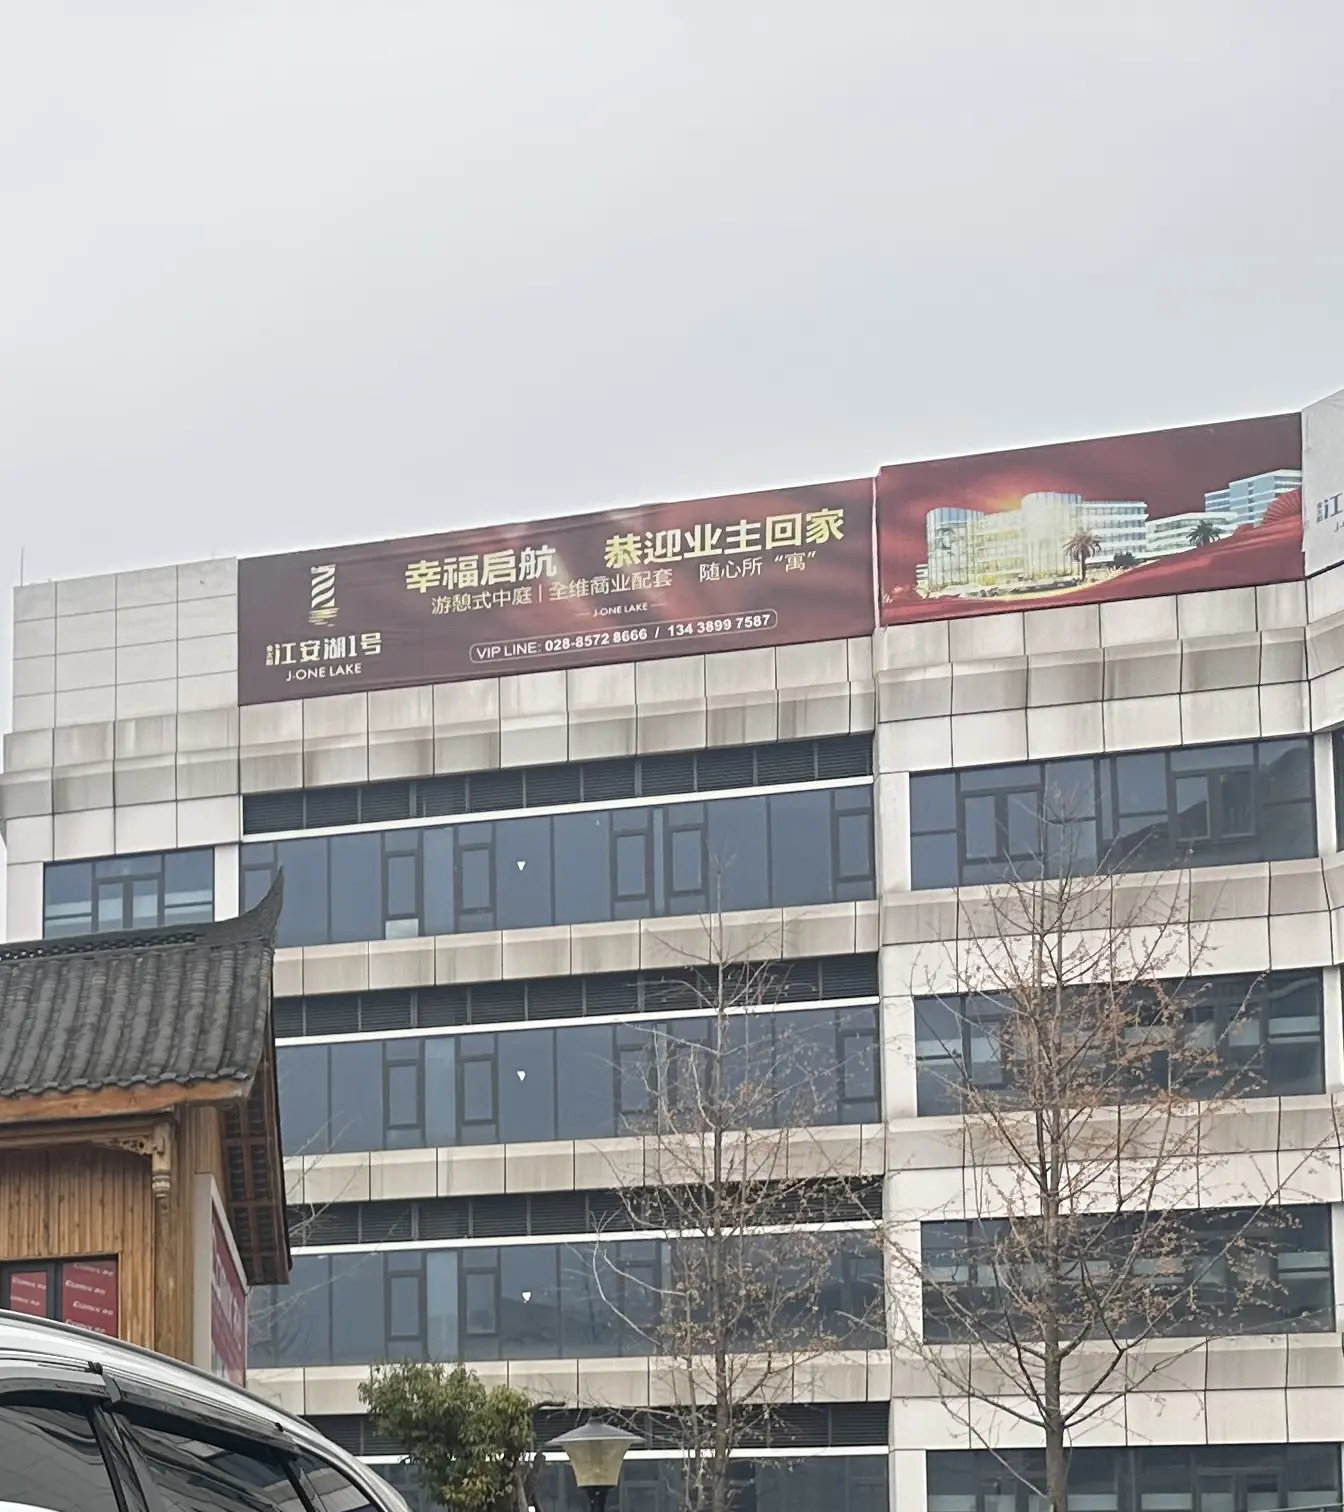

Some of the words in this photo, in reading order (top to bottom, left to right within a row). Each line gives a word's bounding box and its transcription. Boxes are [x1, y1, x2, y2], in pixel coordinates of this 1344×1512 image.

[405, 545, 557, 593] 幸福启航
[604, 508, 845, 568] 恭迎业主回家
[623, 602, 649, 614] LAKE
[476, 646, 501, 660] VIP
[504, 641, 541, 657] LINE:
[544, 633, 610, 652] 028-8572
[612, 628, 648, 643] 8666
[667, 623, 693, 637] 134
[696, 618, 732, 634] 3899
[735, 614, 771, 629] 7587
[329, 662, 362, 677] LAKE
